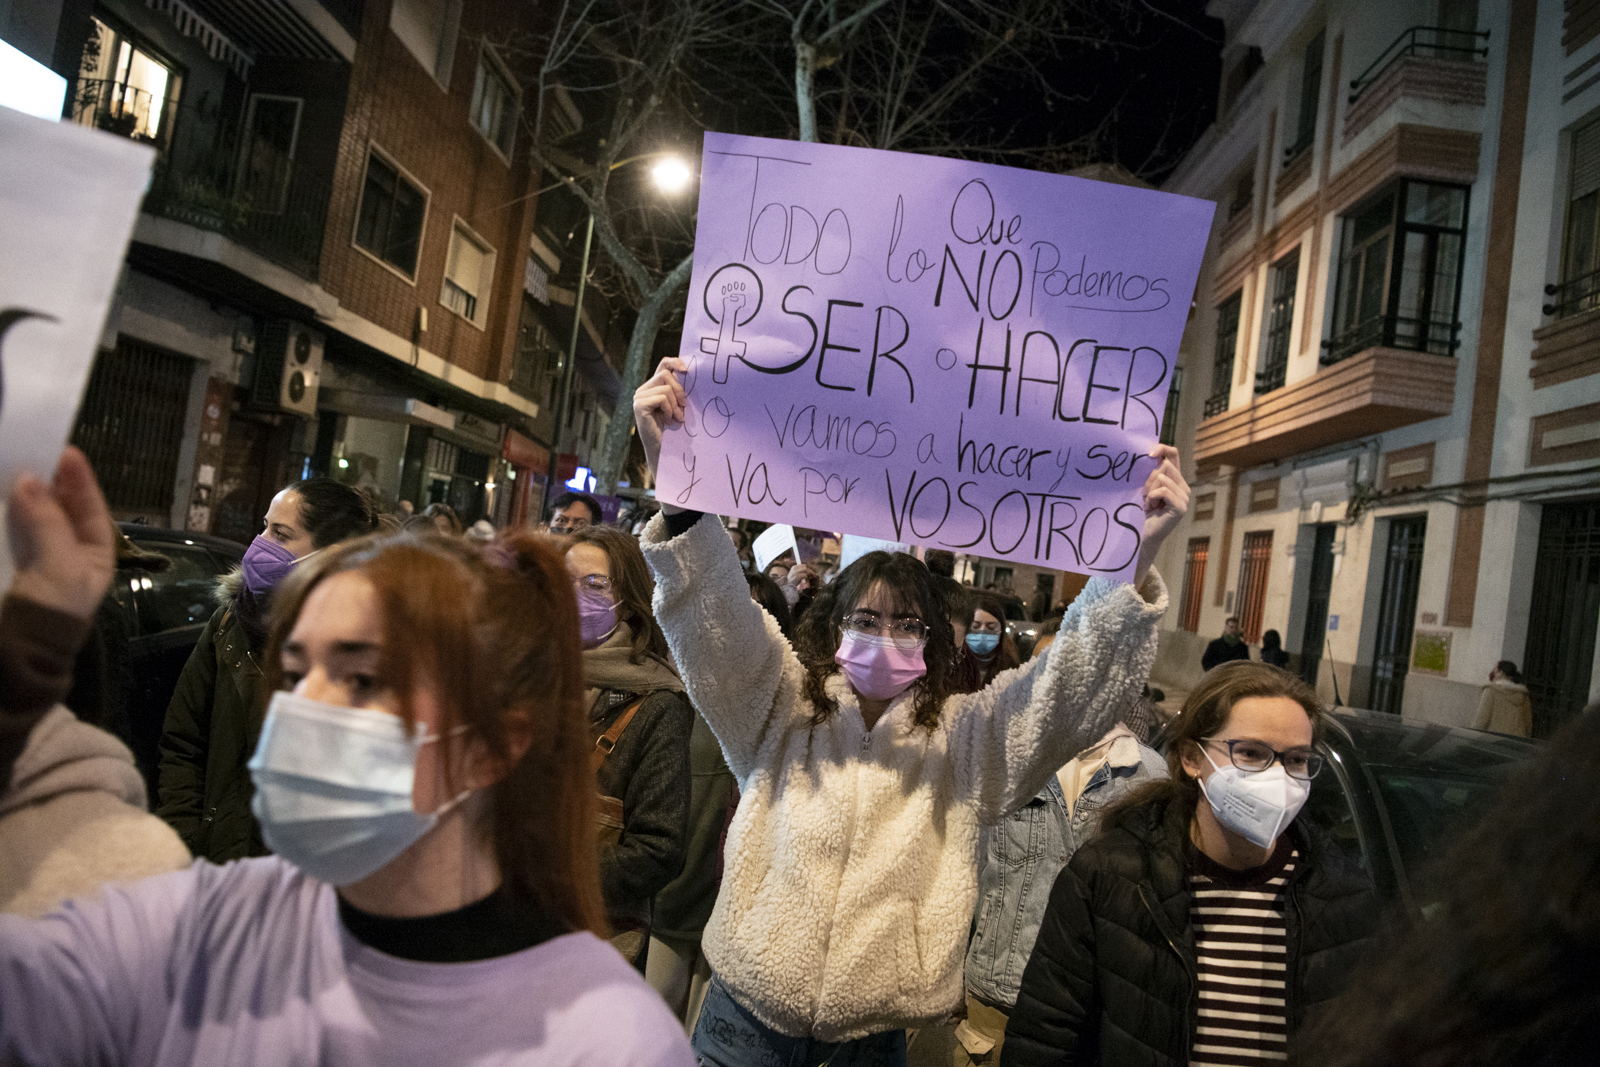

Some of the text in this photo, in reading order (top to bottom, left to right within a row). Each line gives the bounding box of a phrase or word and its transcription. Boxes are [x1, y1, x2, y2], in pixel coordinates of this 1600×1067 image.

[886, 193, 936, 283] lo
[950, 177, 1023, 246] Que
[933, 243, 1023, 321] NO
[1030, 240, 1171, 318] Podemos
[734, 284, 915, 404] SER
[964, 316, 1168, 437] HACER
[916, 432, 942, 464] a
[958, 412, 1052, 481] hacer
[1049, 446, 1072, 493] y
[676, 452, 702, 504] y
[884, 468, 1144, 573] VOSOTROS
